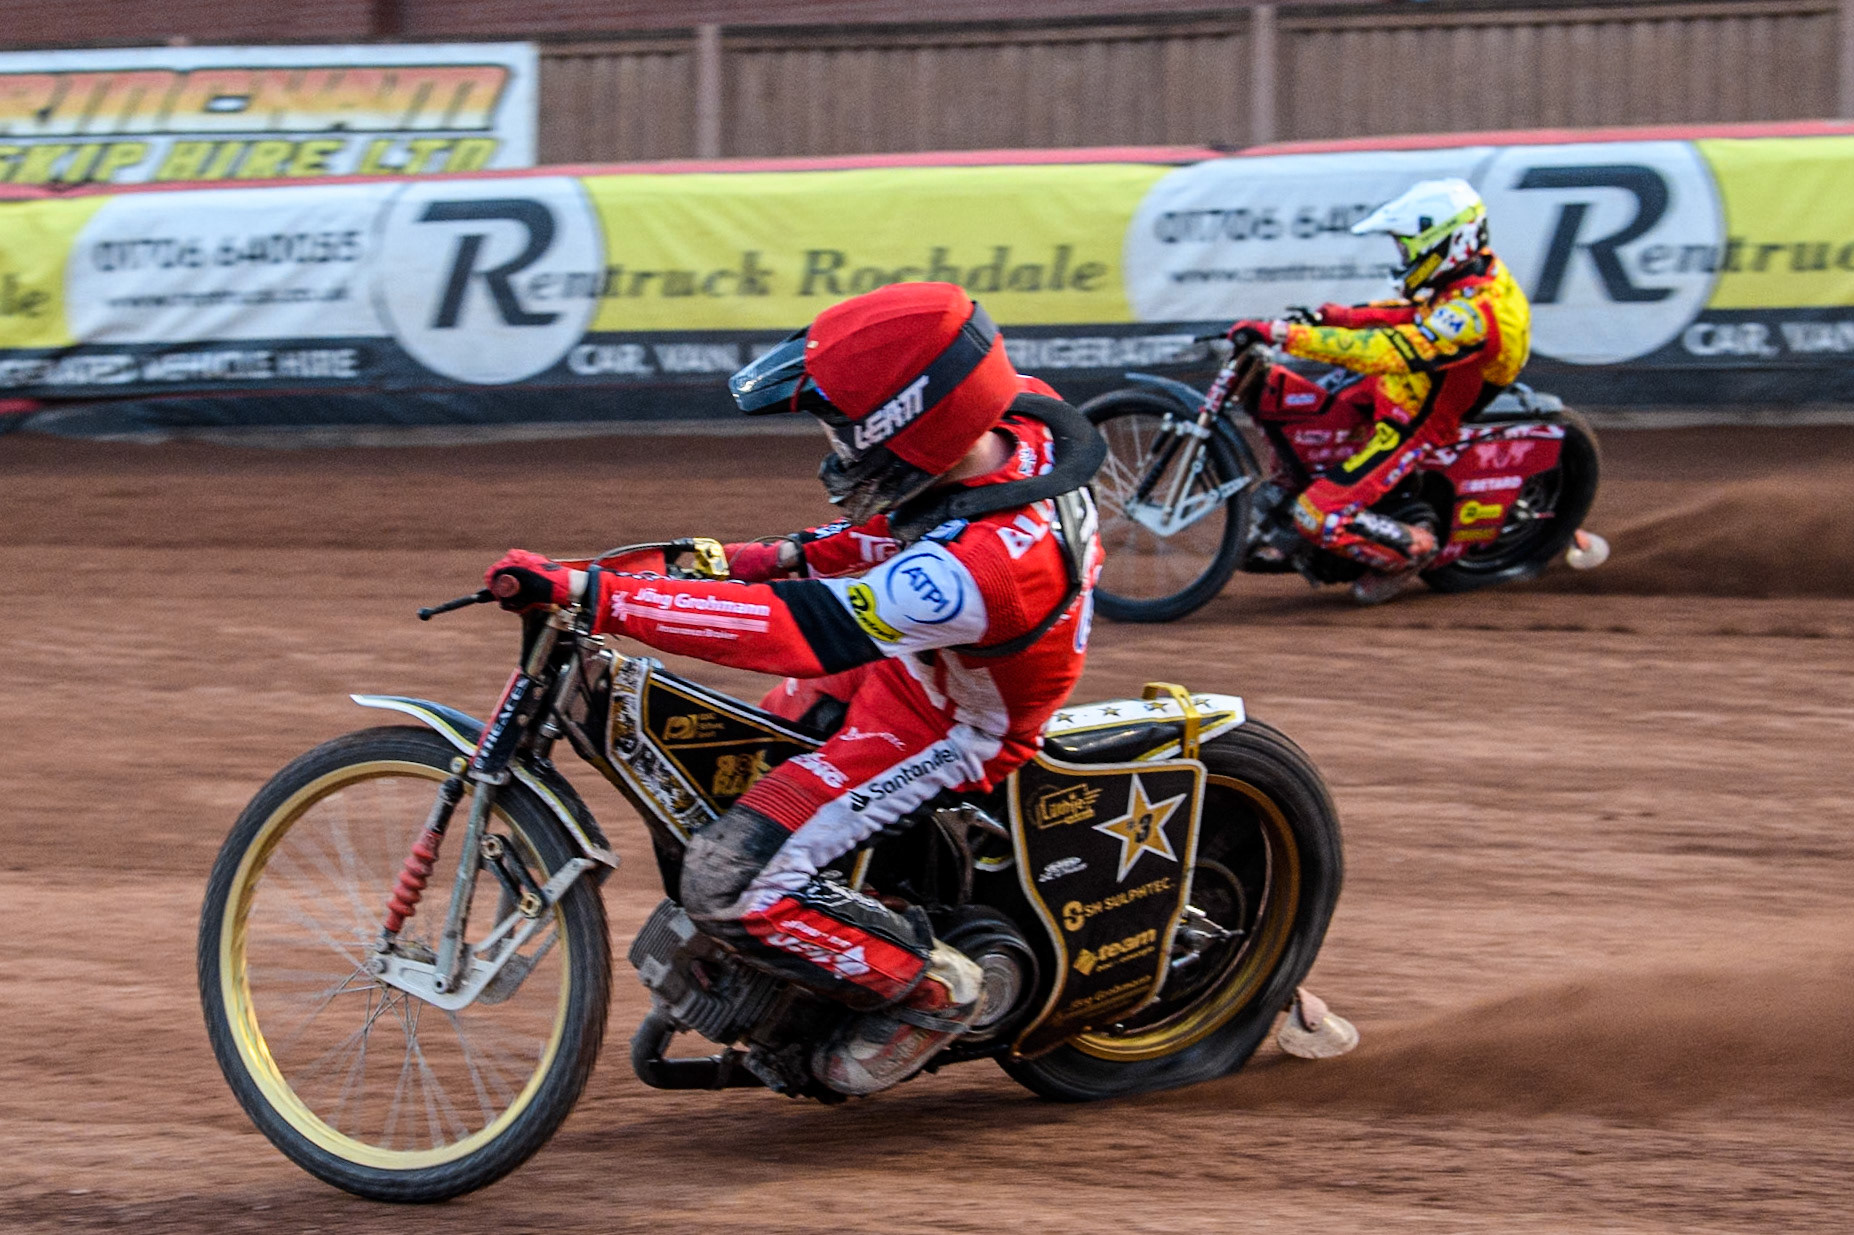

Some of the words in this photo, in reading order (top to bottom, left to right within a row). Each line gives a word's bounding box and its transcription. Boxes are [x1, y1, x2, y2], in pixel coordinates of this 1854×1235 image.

[154, 139, 343, 181] HIRE
[356, 137, 500, 176] LTD
[278, 349, 359, 379] HIRE
[867, 744, 962, 801] Santander
